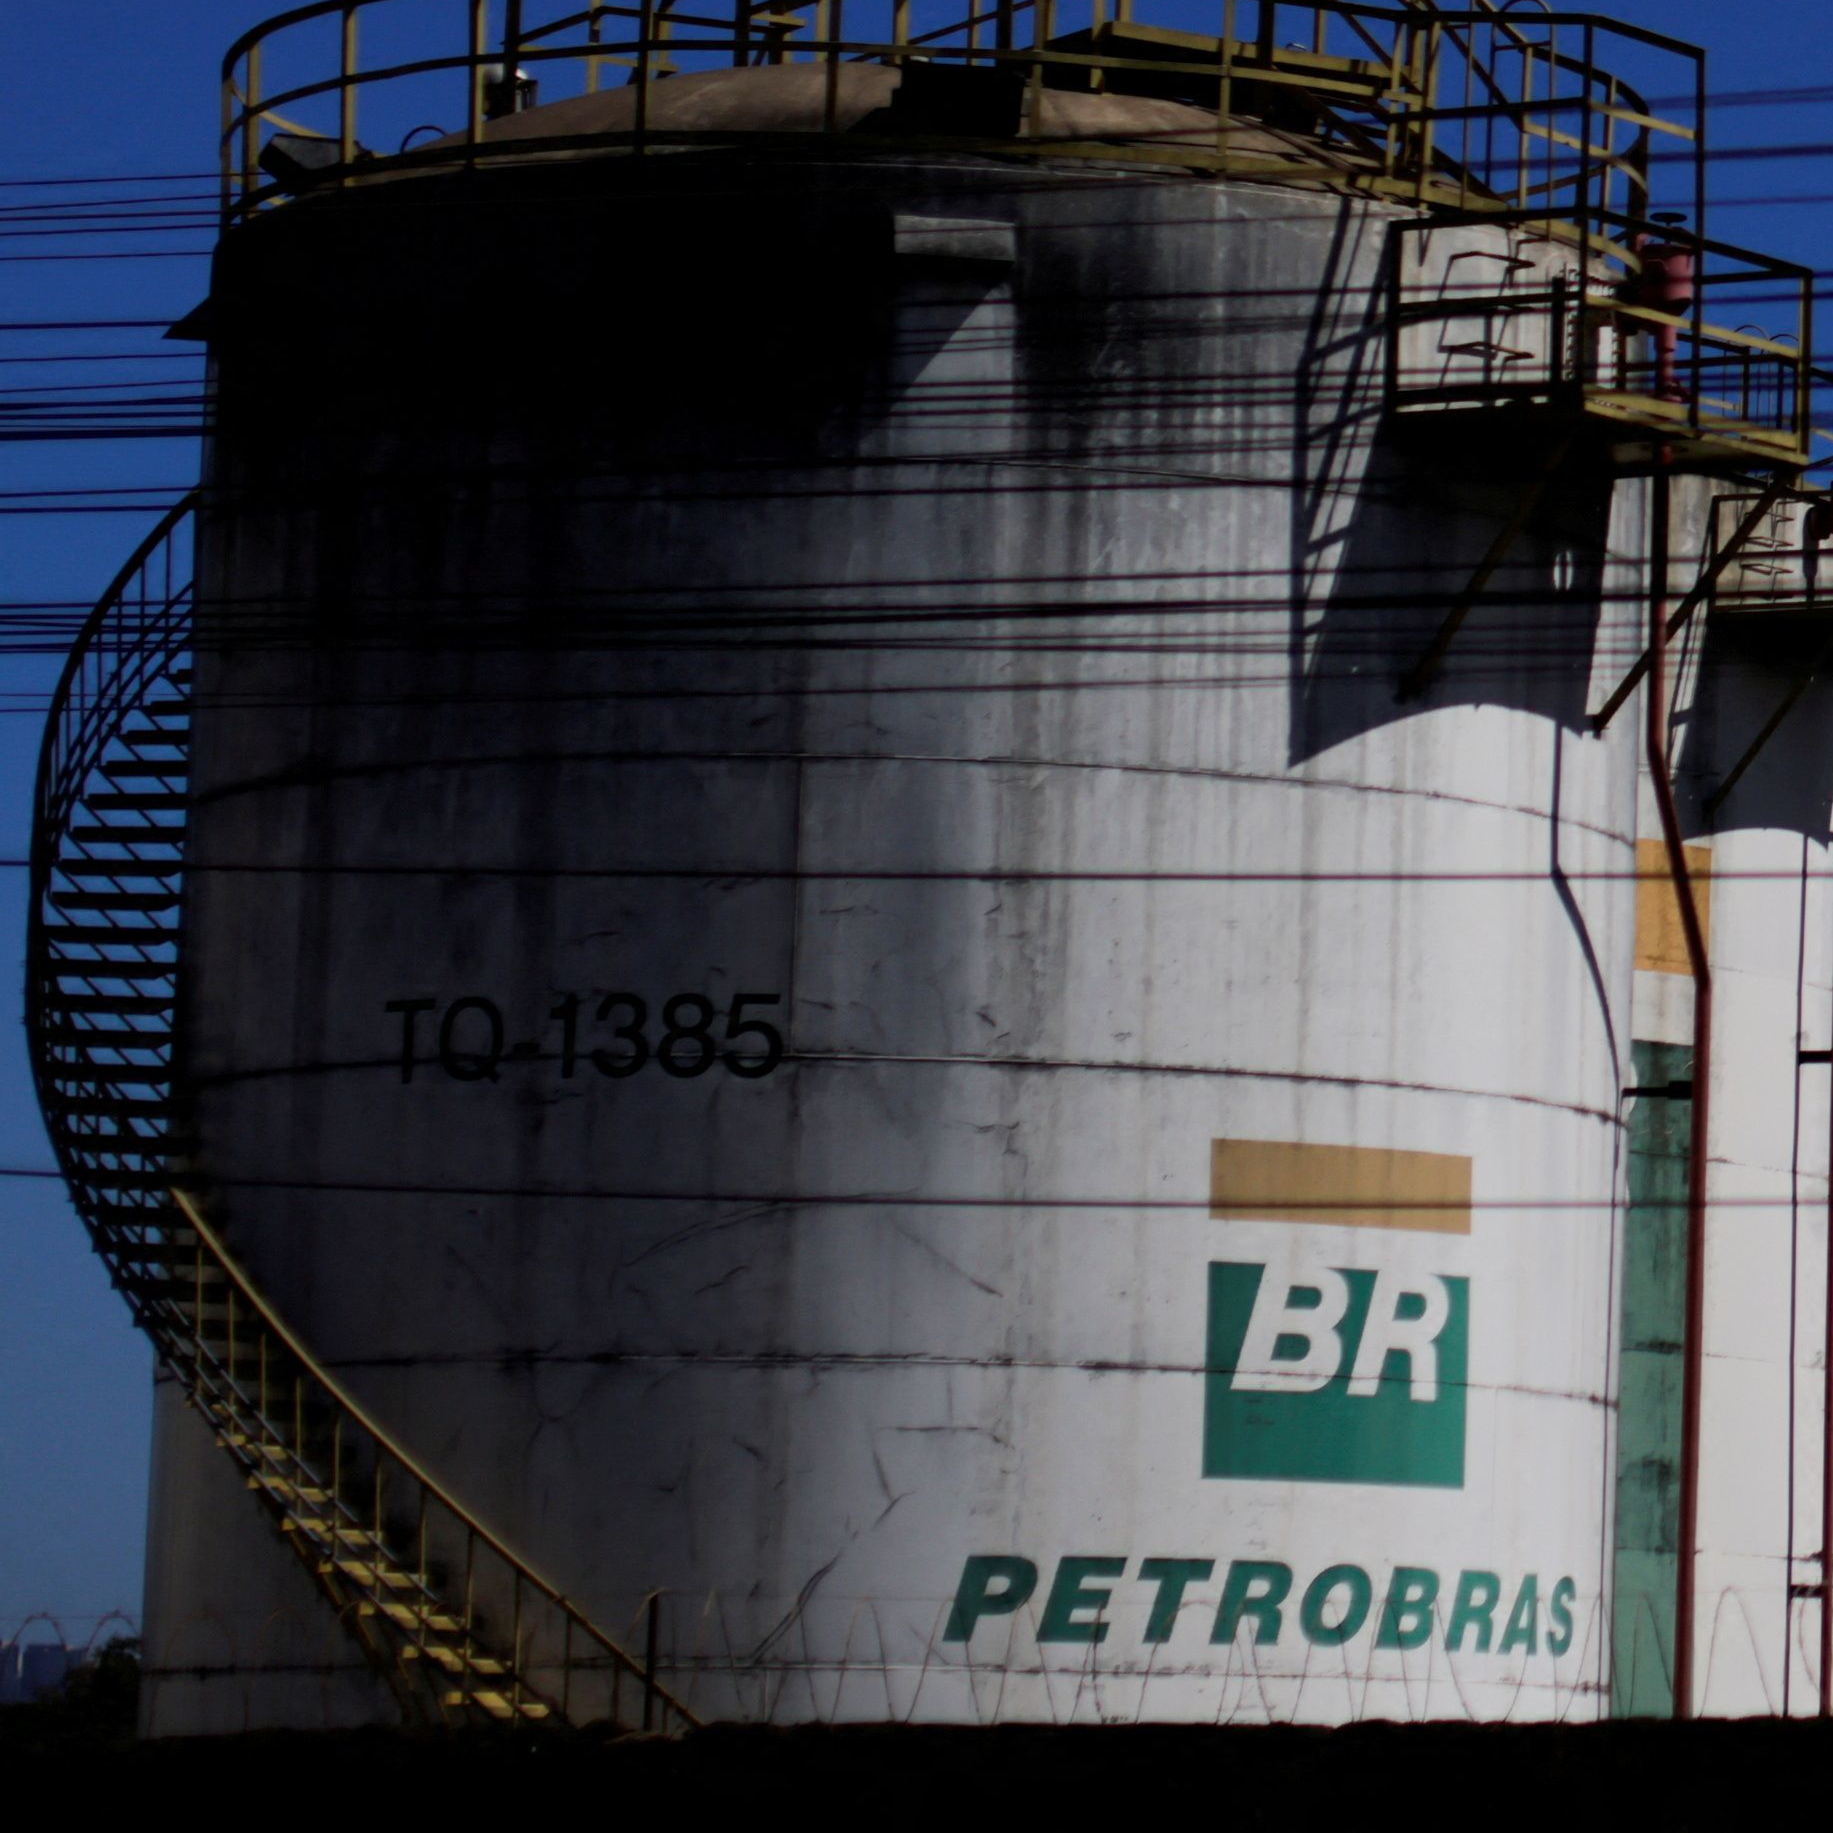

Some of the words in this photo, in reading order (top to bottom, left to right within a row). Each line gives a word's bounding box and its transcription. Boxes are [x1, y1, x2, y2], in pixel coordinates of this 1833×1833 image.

[385, 993, 783, 1084] TQ-1385
[1230, 1263, 1451, 1403] BR
[943, 1555, 1576, 1657] PETROBRAS
